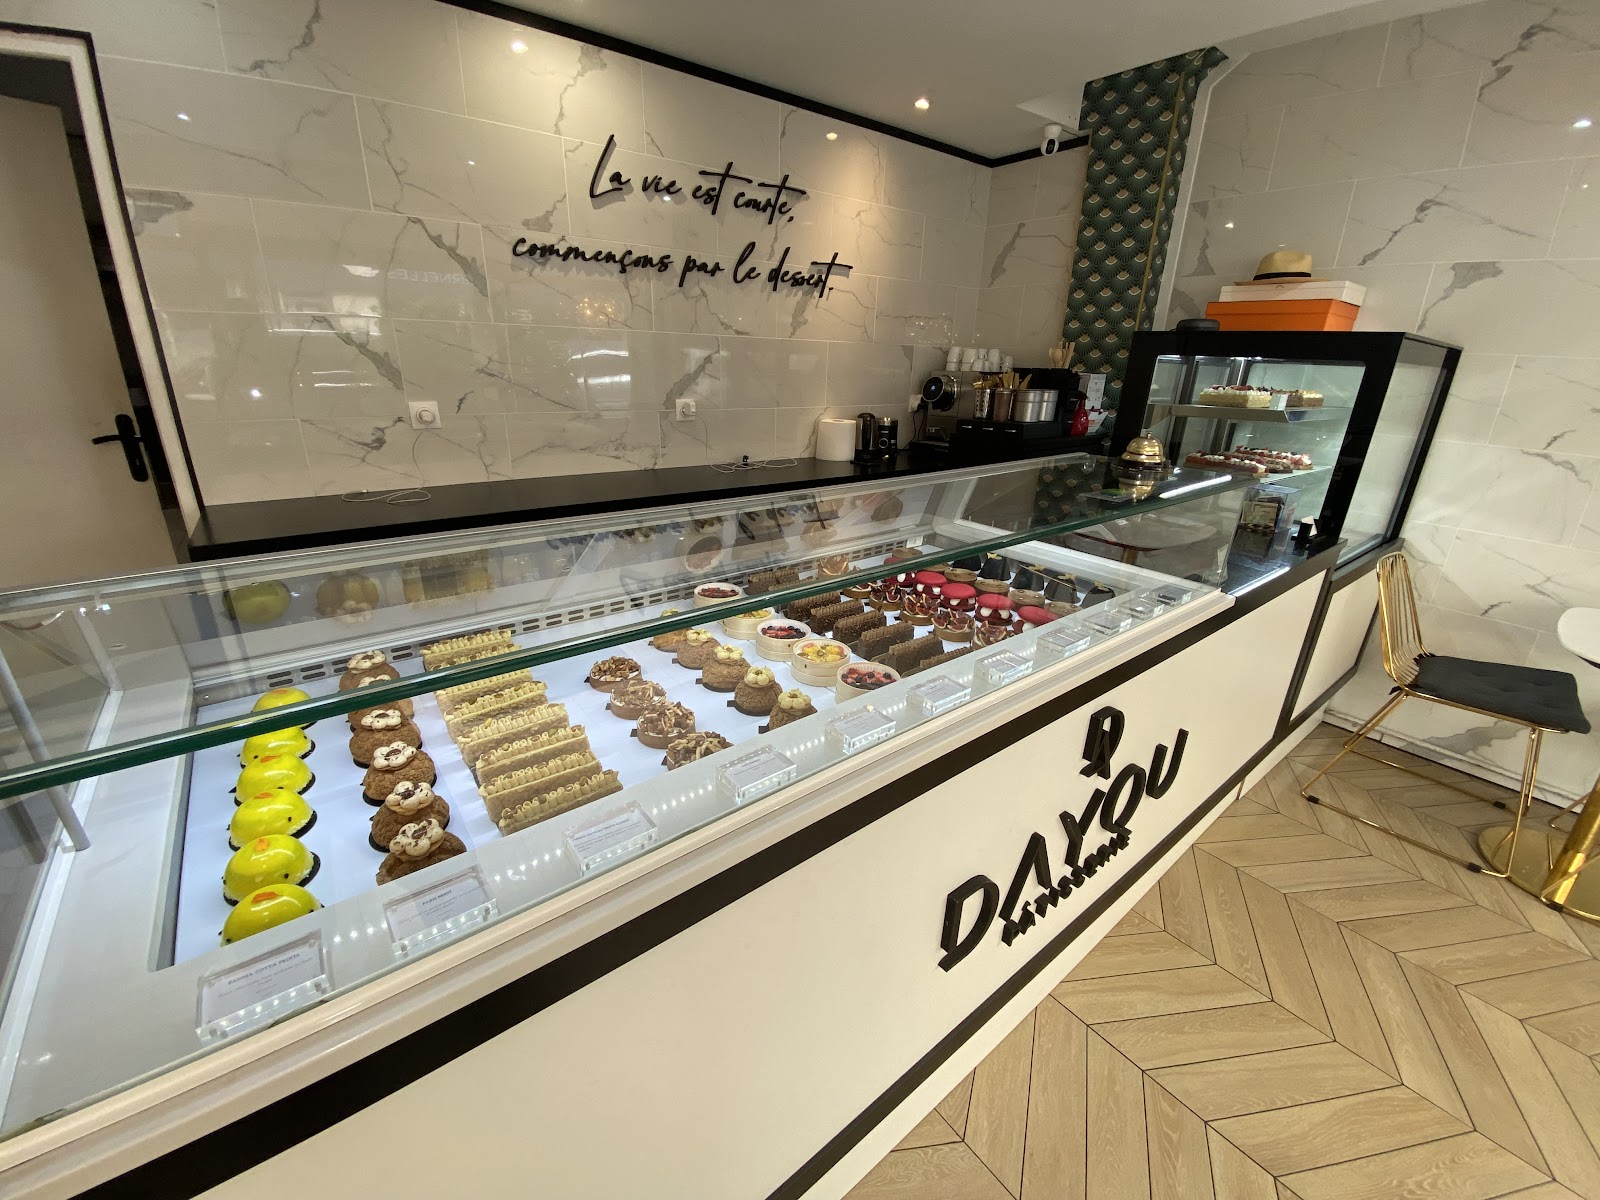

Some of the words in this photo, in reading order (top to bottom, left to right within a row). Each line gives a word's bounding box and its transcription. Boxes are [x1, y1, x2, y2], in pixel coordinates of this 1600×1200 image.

[589, 134, 631, 198] La
[641, 175, 682, 195] vie
[692, 161, 753, 215] est
[733, 174, 807, 225] courte,
[512, 237, 674, 274] commençons
[679, 255, 725, 287] par
[733, 241, 761, 283] le
[937, 727, 1190, 973] DAYOU
